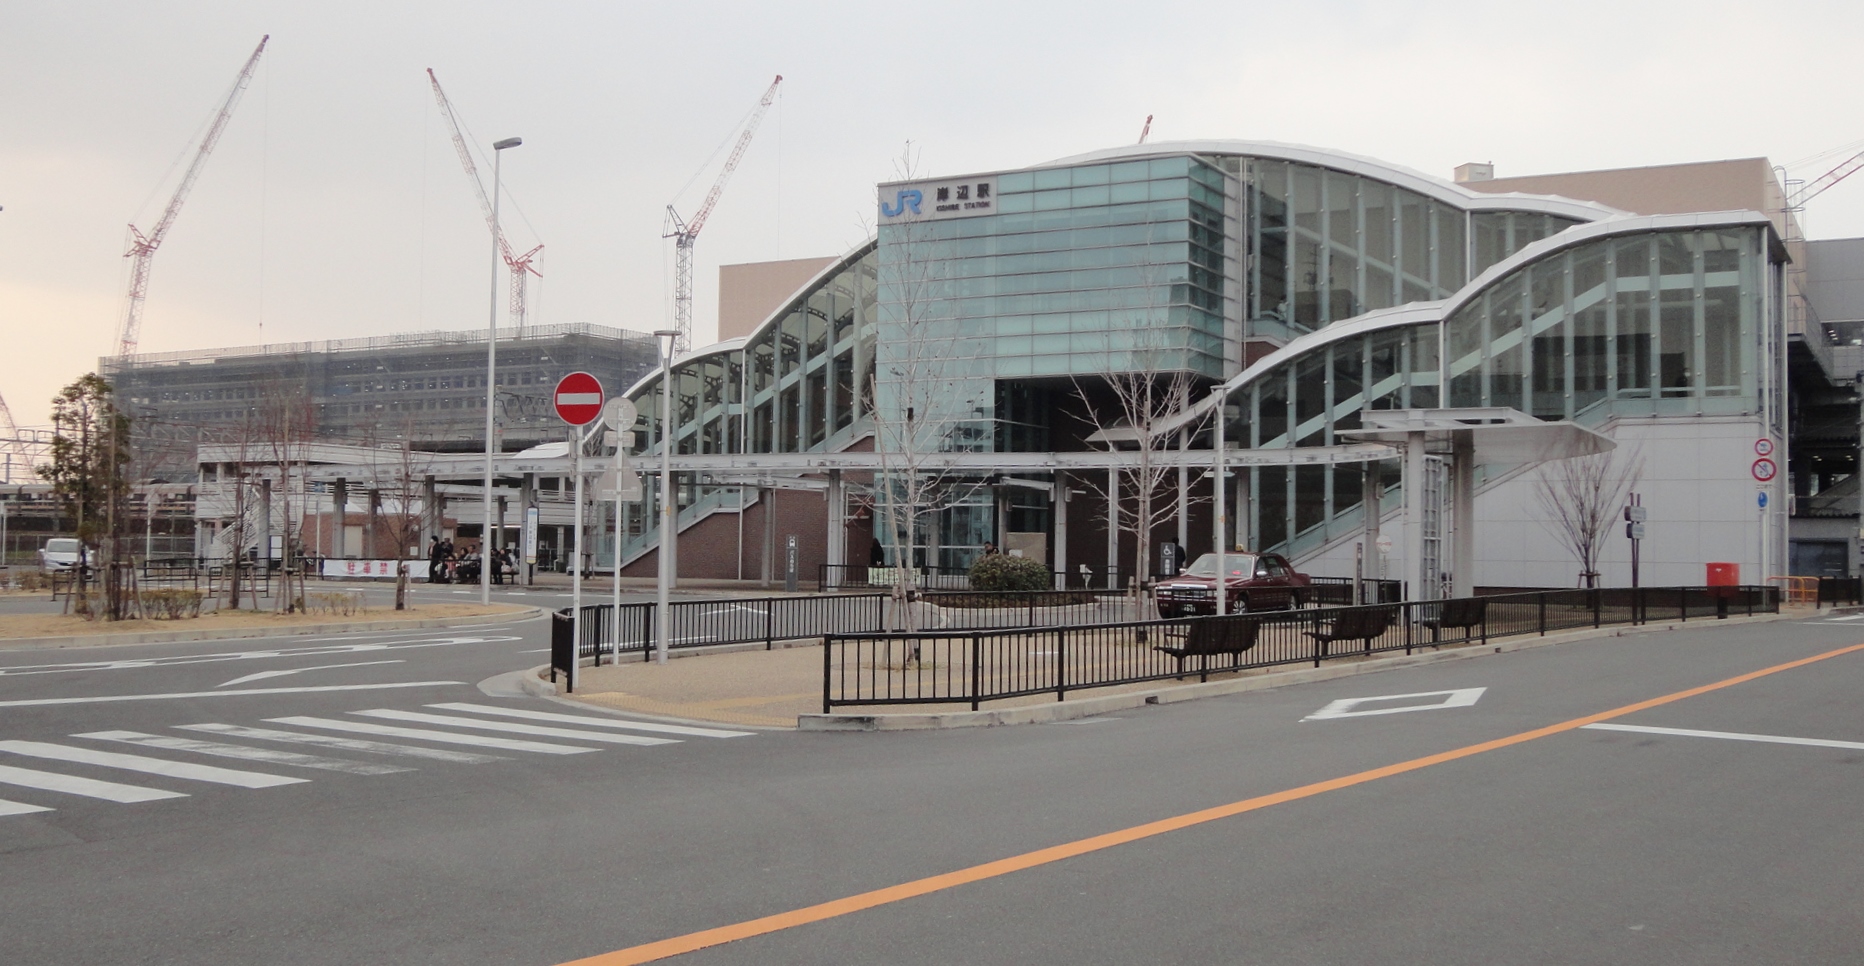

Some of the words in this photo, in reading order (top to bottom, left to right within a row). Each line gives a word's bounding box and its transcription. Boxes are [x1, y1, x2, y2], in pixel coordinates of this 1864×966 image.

[881, 189, 923, 217] JR
[964, 201, 991, 210] STATION
[347, 562, 406, 575] 駐車禁
